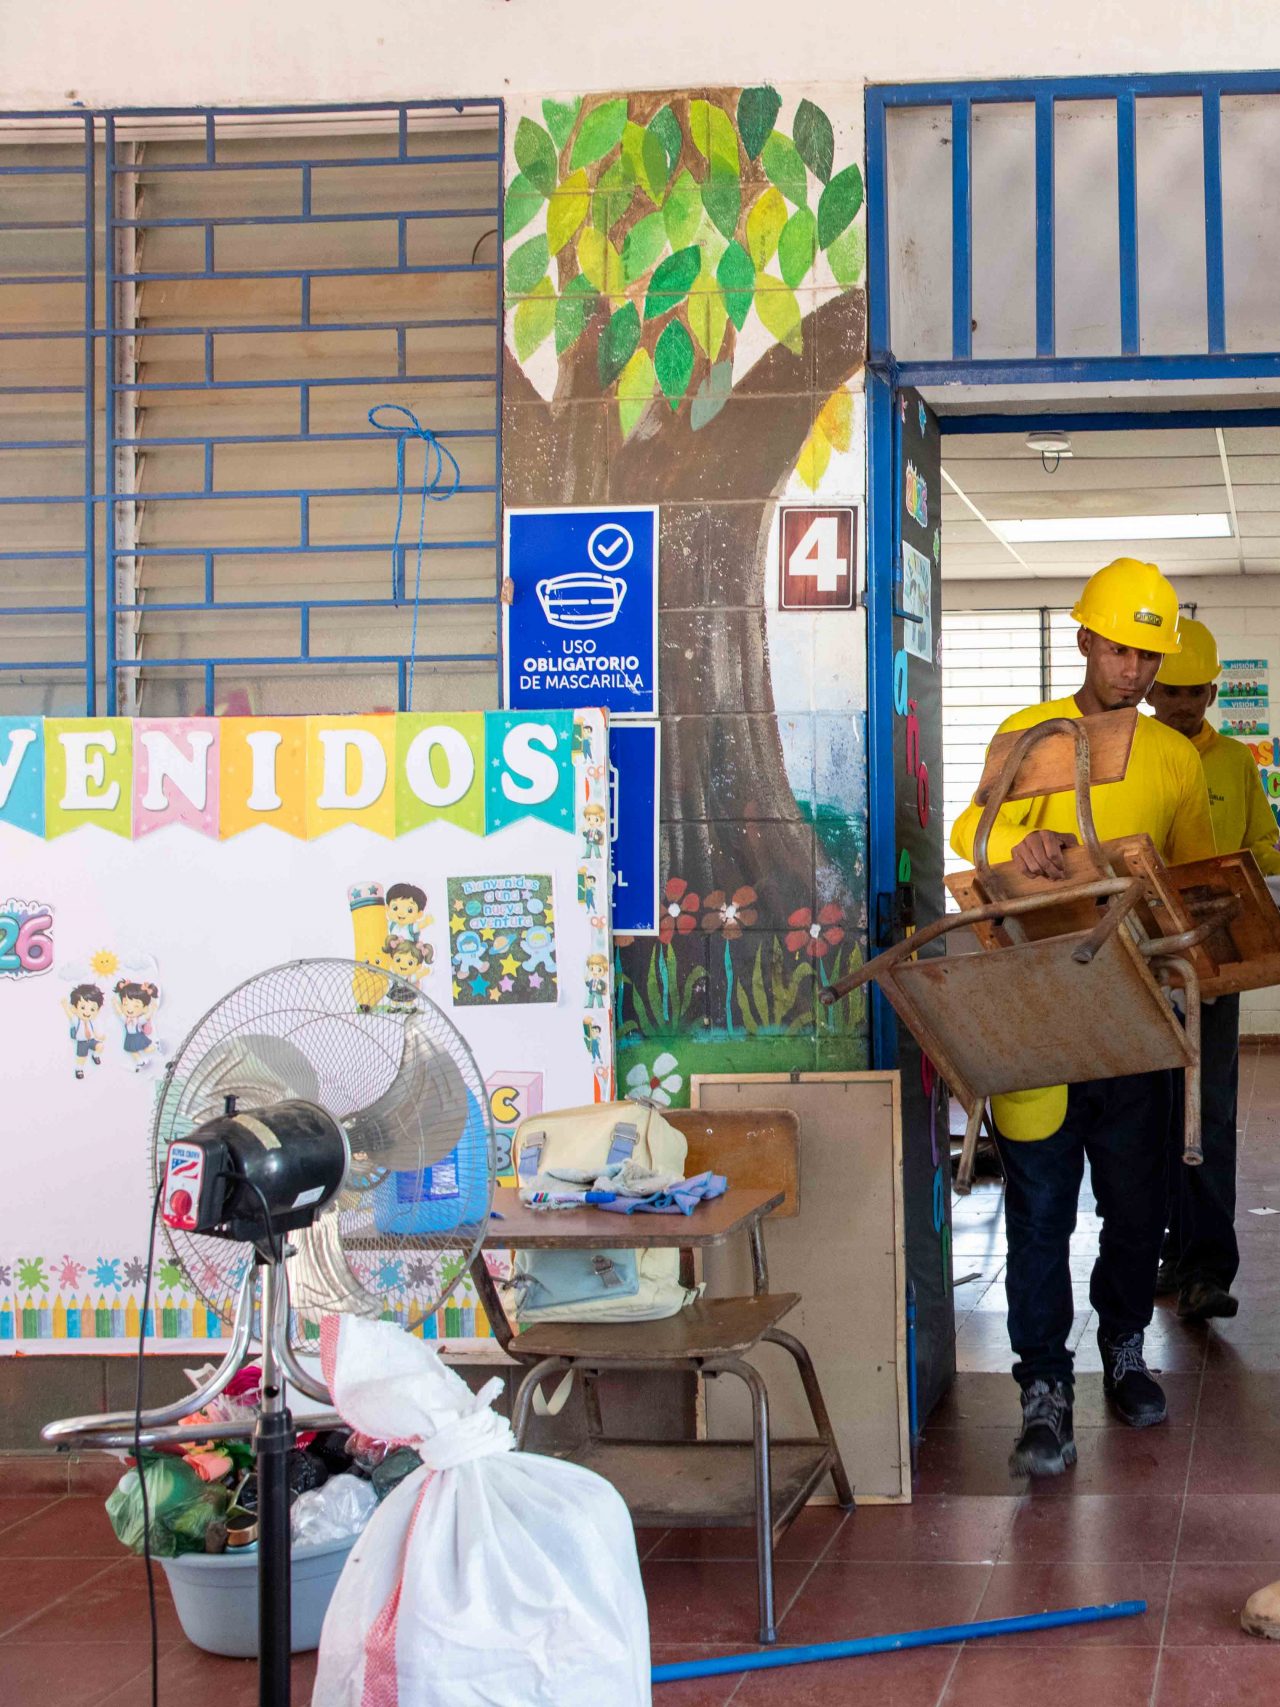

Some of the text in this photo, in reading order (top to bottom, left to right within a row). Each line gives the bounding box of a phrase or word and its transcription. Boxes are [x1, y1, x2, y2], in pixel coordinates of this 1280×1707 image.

[788, 516, 847, 592] 4
[562, 639, 597, 654] USO
[523, 656, 640, 672] OBLIGATORIO
[520, 673, 644, 690] DE MASCARILLA
[464, 876, 540, 895] Bienvenidos
[470, 915, 534, 929] aventura
[490, 1086, 521, 1124] C
[487, 1133, 513, 1171] B
